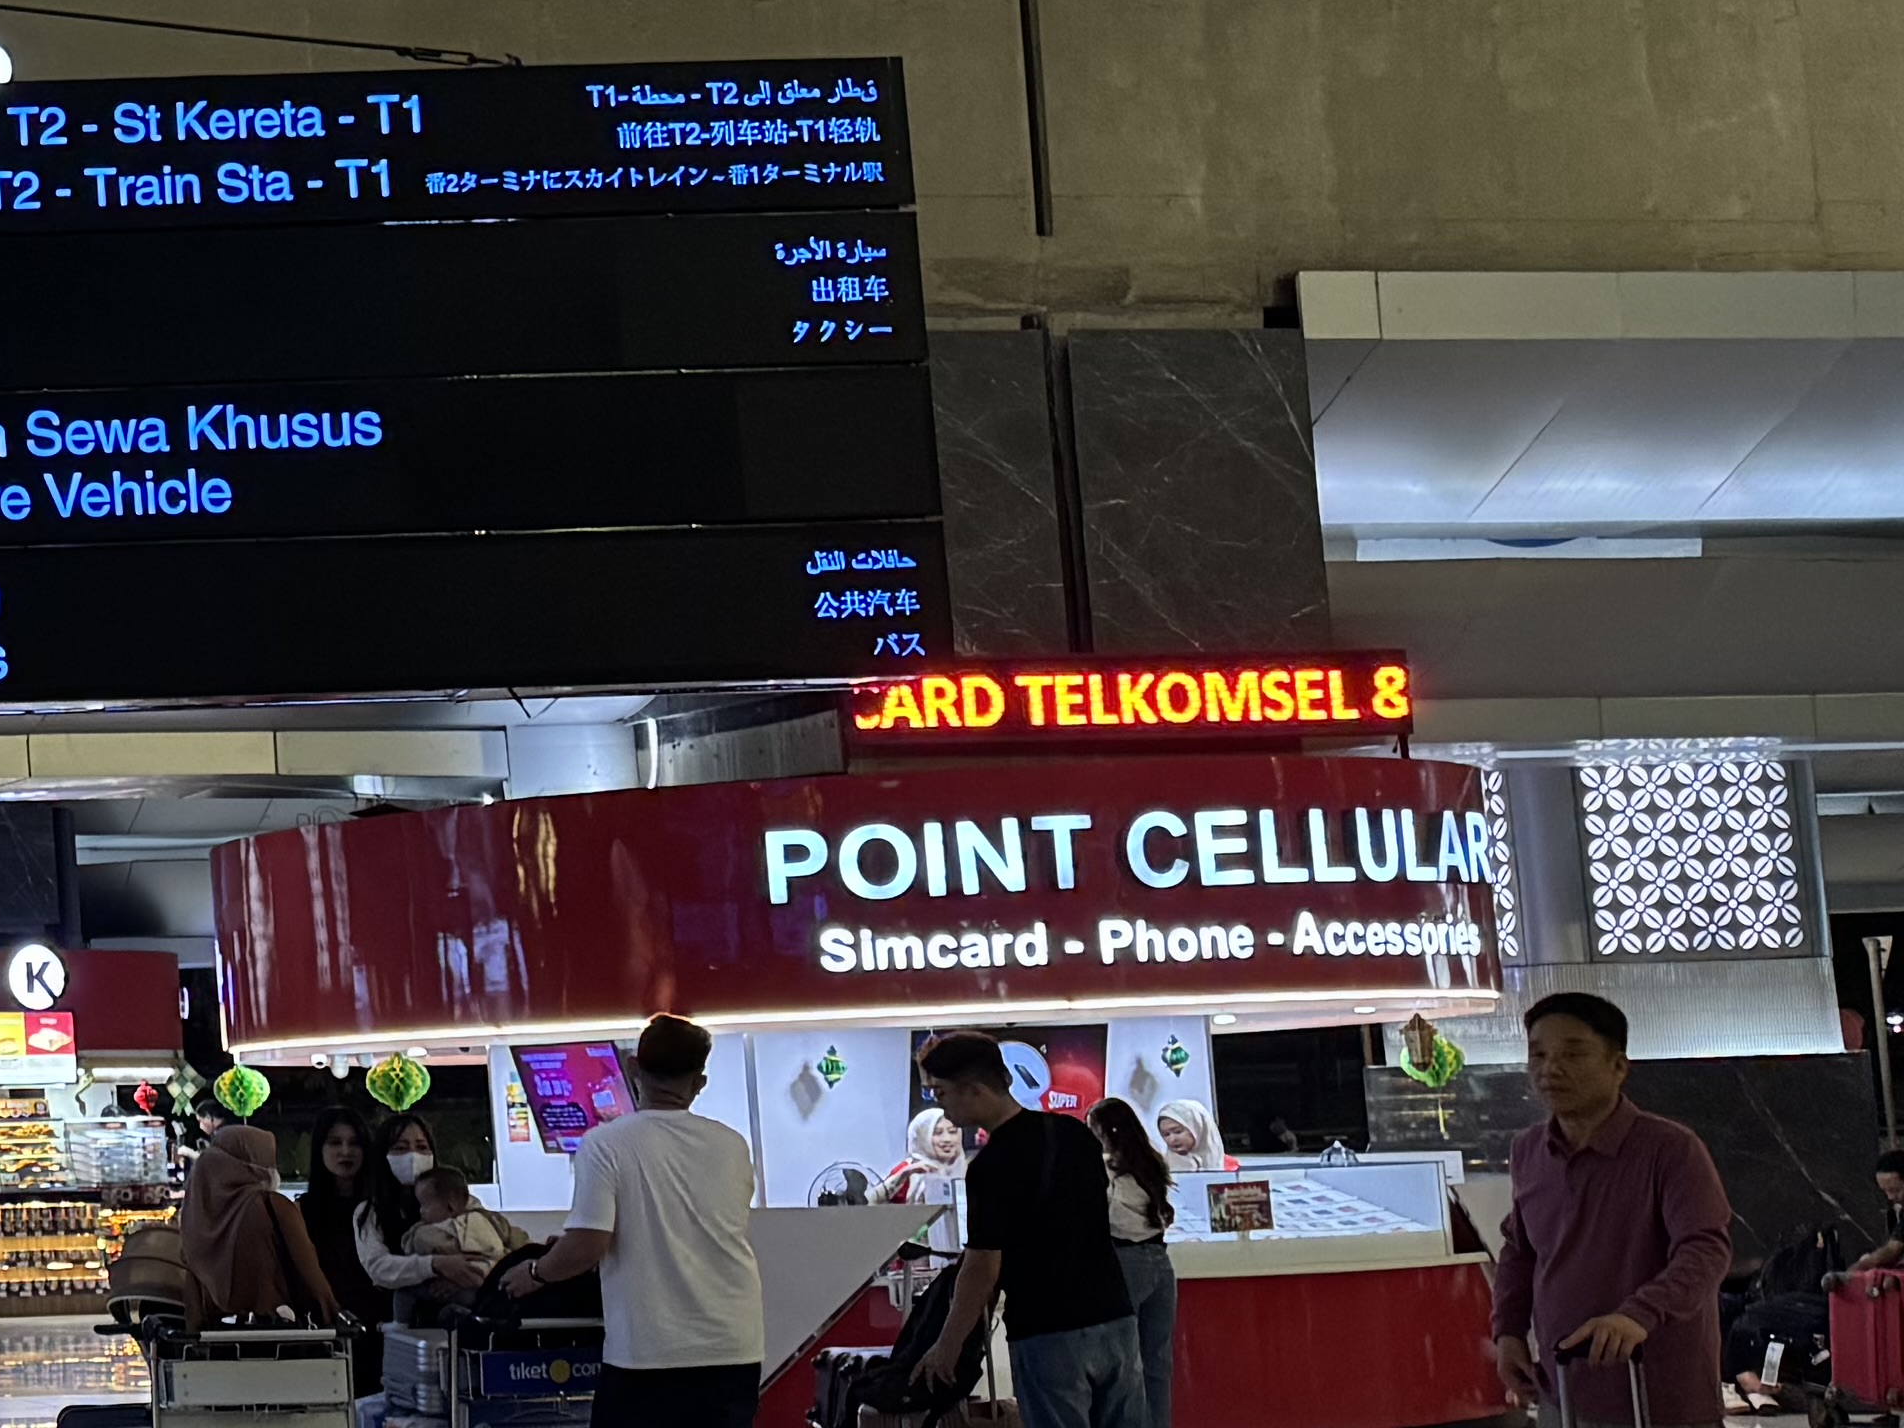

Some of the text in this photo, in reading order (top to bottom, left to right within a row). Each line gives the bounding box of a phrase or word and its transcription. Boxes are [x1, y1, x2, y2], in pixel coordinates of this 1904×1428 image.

[705, 80, 738, 107] T2
[6, 105, 67, 146] T2
[113, 101, 163, 144] St
[175, 99, 327, 141] Kereta
[366, 93, 422, 135] T1
[83, 164, 202, 208] Train
[216, 161, 295, 205] Sta
[334, 158, 391, 198] T1
[811, 274, 890, 303] 出租车
[792, 319, 893, 344] タクシー
[26, 409, 170, 457] Sewa
[186, 403, 382, 451] Khusus
[42, 467, 232, 518] Vehicle
[813, 588, 921, 619] 公共汽车
[873, 632, 926, 657] バス
[1014, 668, 1361, 726] TELKOMSEL
[764, 807, 1493, 904] POINT CELLULAR
[819, 921, 1049, 972] Simcard
[1098, 918, 1255, 965] Phone
